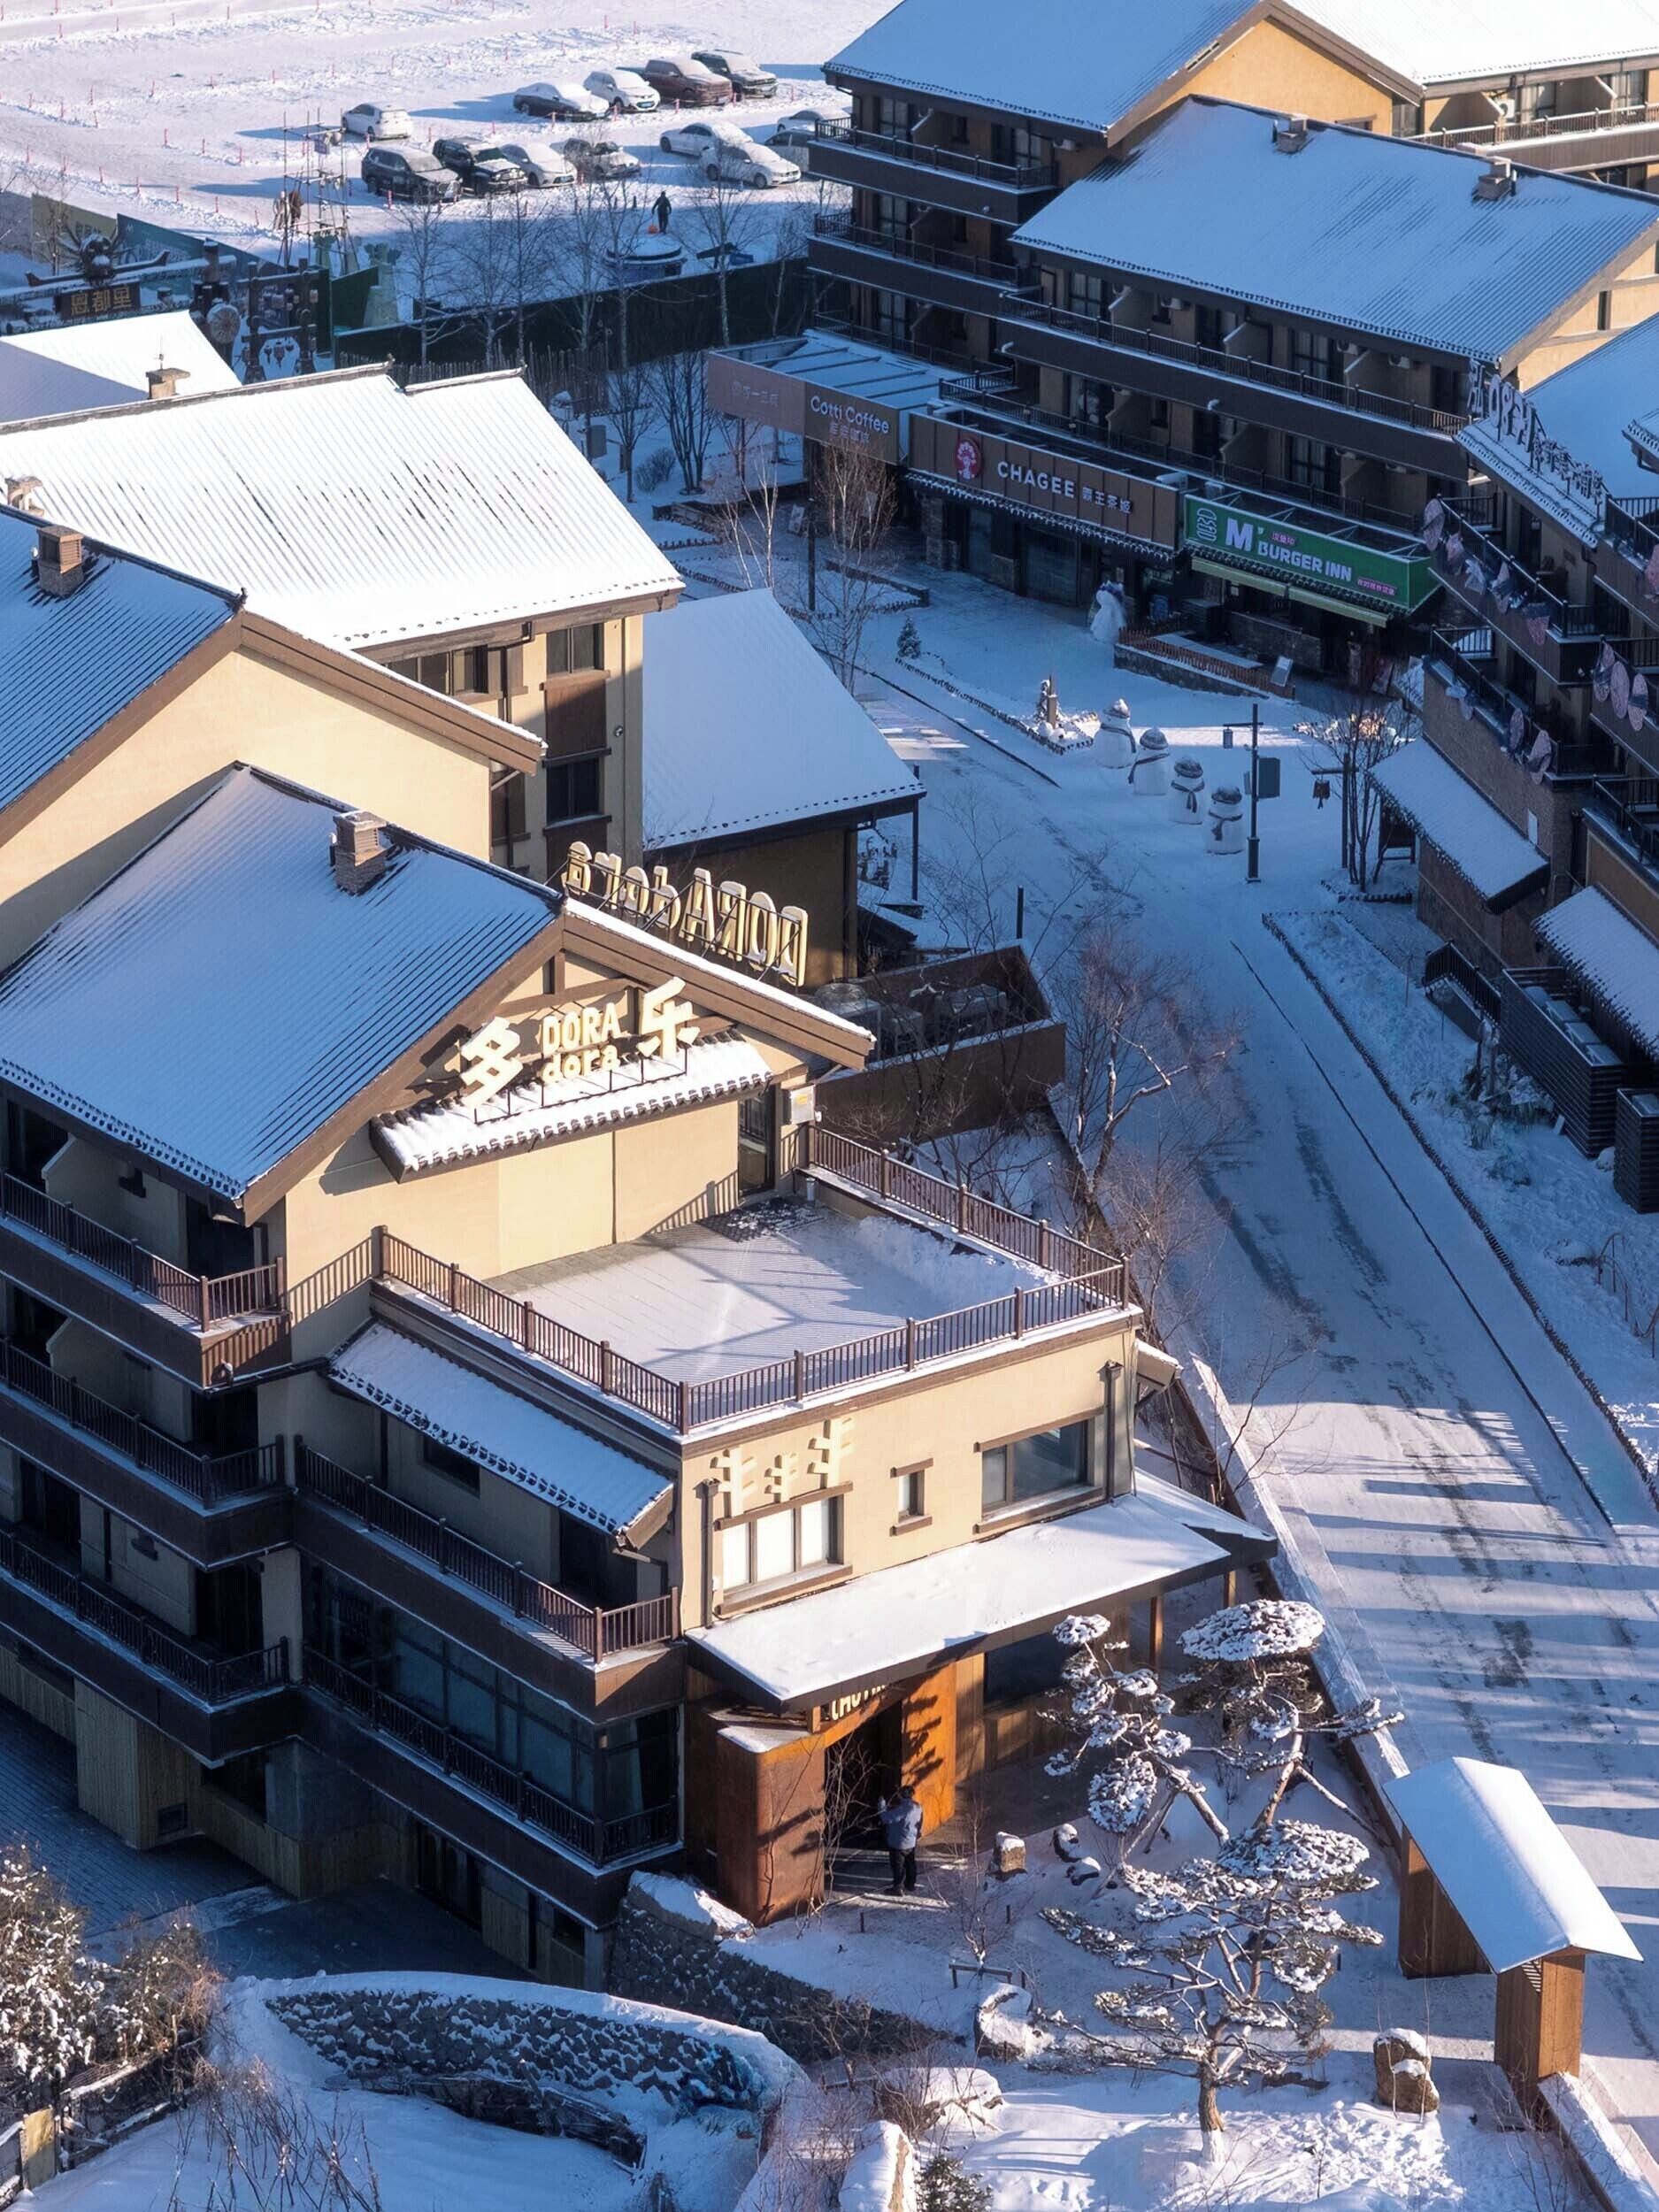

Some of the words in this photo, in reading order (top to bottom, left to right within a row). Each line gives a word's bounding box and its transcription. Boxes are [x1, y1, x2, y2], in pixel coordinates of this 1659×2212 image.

[810, 395, 842, 420] Cotti
[845, 406, 889, 434] Coffee
[997, 461, 1076, 499] CHAGEE
[1257, 541, 1323, 572] BURGER
[1325, 560, 1353, 581] INN
[541, 1002, 621, 1056] DORA
[541, 1044, 621, 1085] dora
